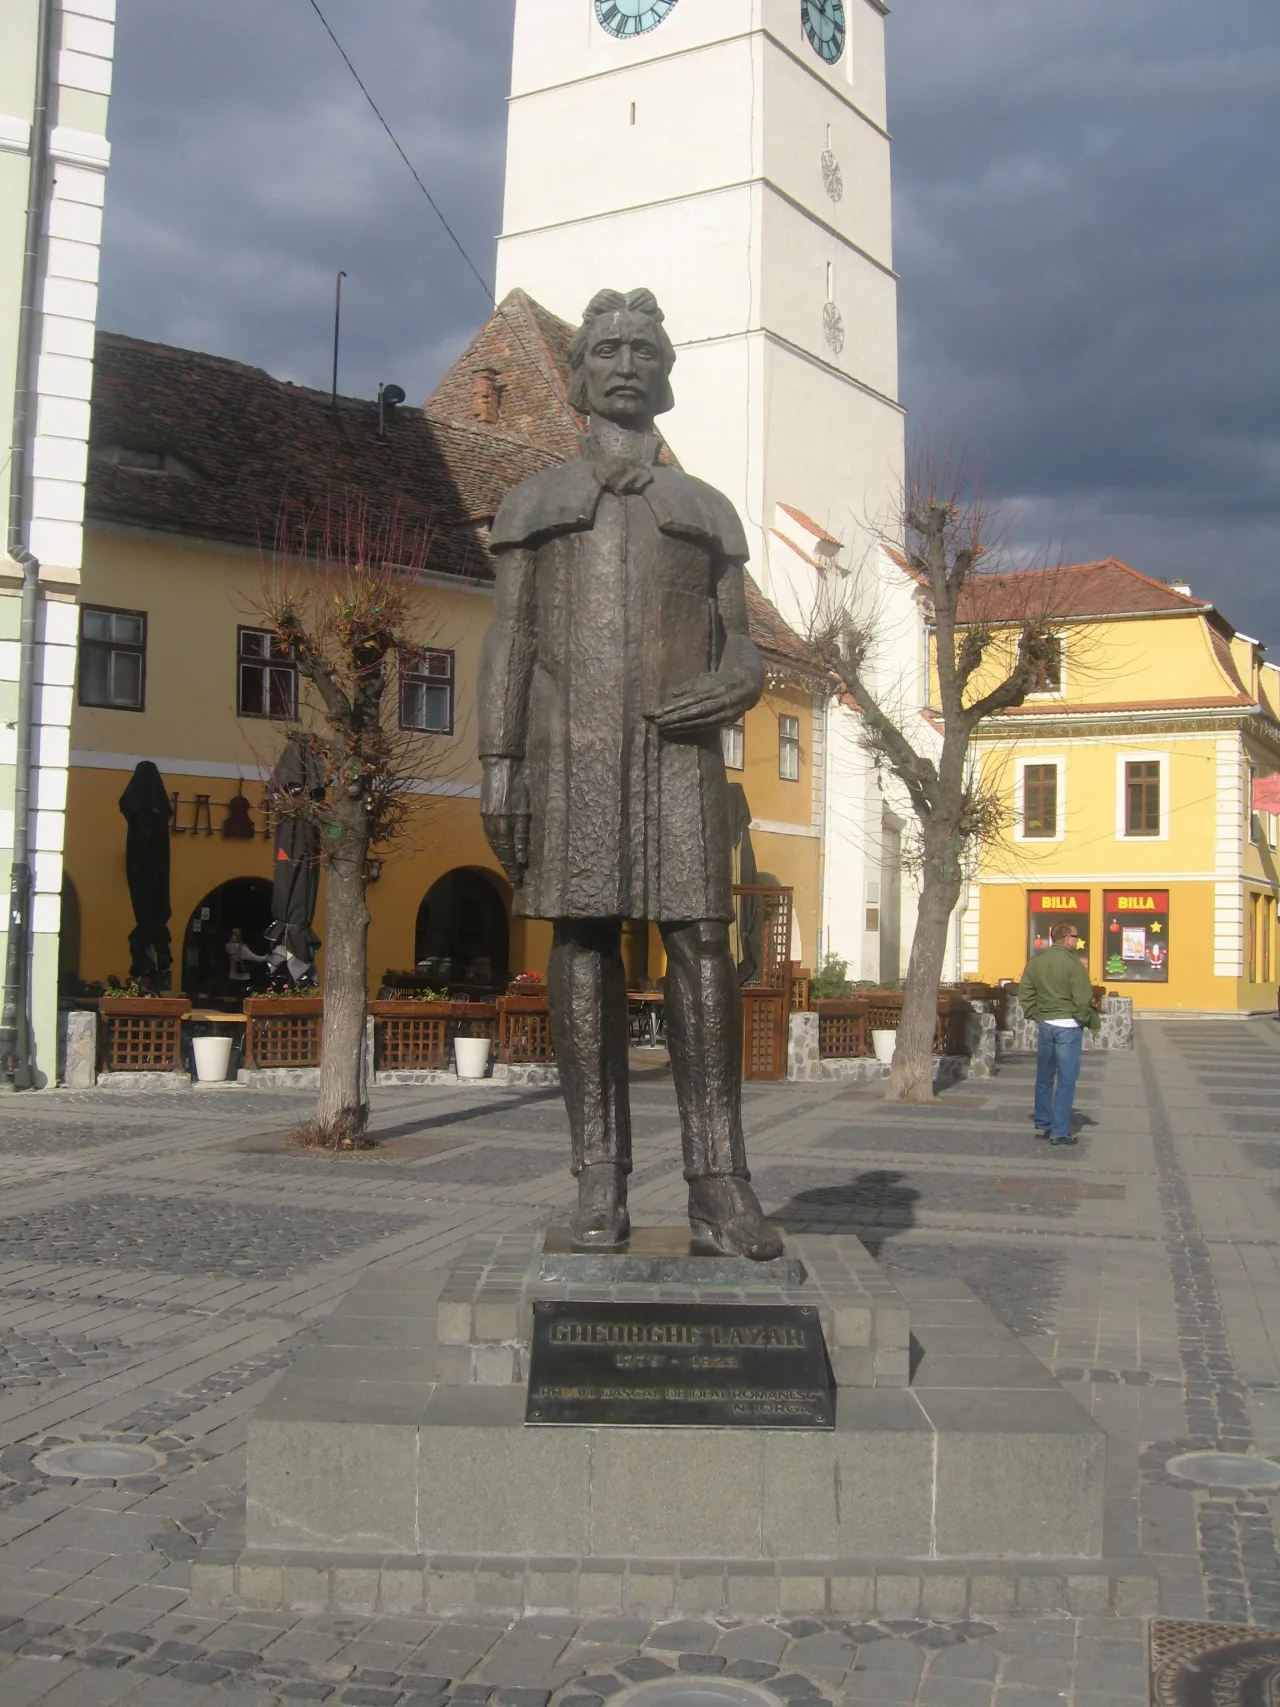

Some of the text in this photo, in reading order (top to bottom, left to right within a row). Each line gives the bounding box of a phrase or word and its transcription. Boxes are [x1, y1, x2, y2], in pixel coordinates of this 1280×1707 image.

[1041, 896, 1078, 909] BILLA
[1117, 896, 1155, 910] BILLA
[550, 1324, 701, 1345] GHEORGHE
[665, 1387, 684, 1399] DE
[687, 1388, 726, 1400] IDEAL
[753, 1403, 812, 1416] IORGA
